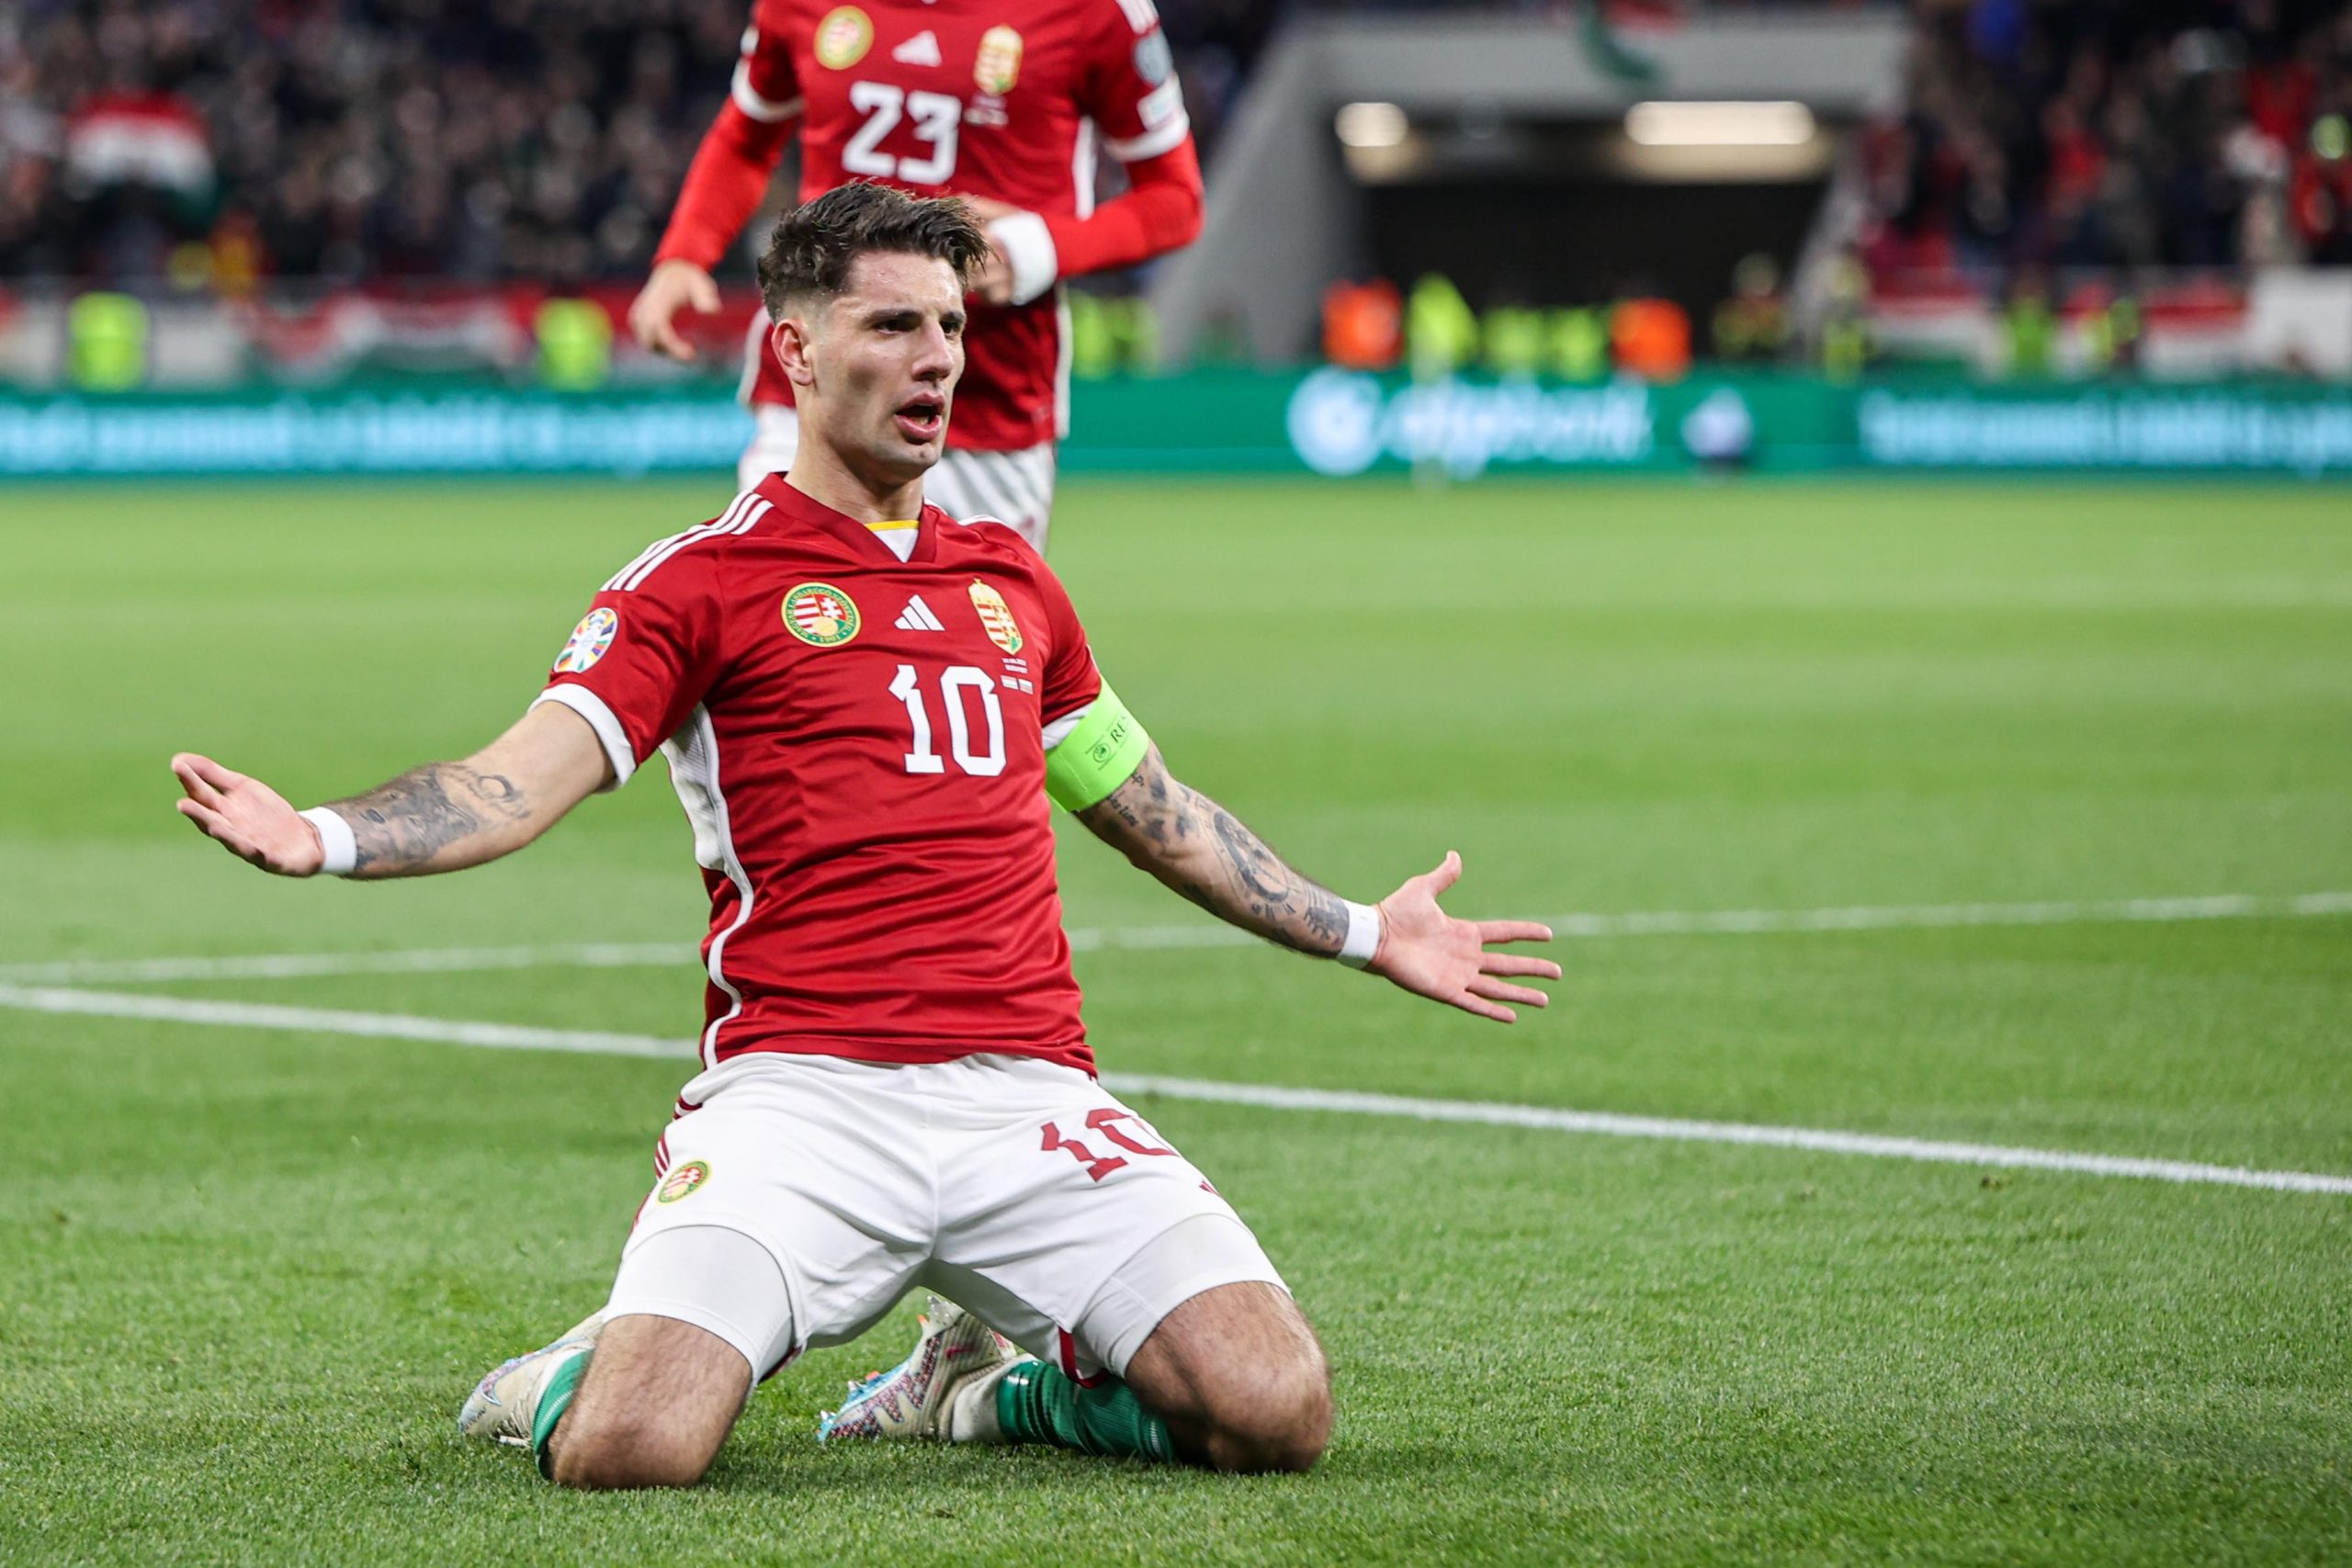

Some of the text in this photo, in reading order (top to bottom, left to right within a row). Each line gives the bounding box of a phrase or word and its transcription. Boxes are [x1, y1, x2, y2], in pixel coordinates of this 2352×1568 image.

[842, 80, 961, 185] 23
[888, 664, 1007, 777] 10
[1040, 1108, 1181, 1183] 10
